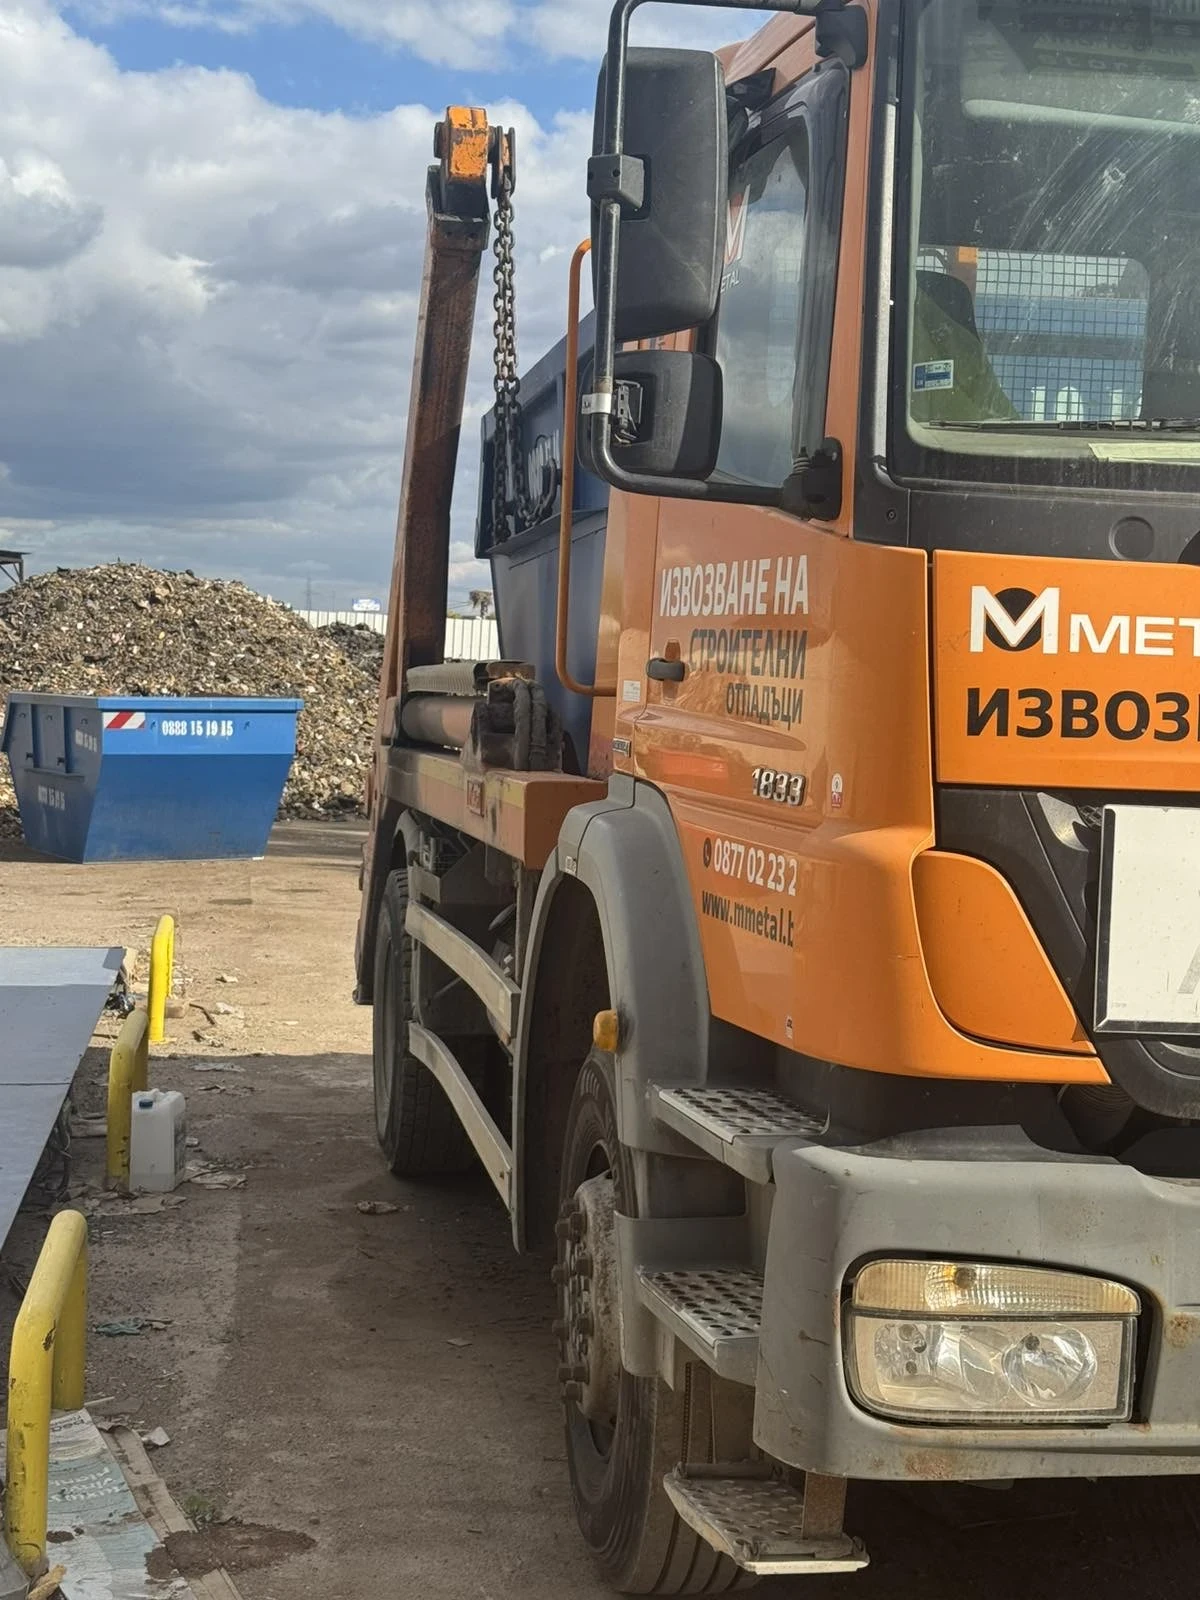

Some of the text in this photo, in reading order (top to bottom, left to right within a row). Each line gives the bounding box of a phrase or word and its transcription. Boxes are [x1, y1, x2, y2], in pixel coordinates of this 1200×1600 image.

[720, 268, 741, 294] ETAL
[660, 555, 809, 617] ИЗВОЗВАНЕ НА
[689, 628, 809, 681] СТРОИТЕЛНИ
[161, 720, 187, 736] 0888
[190, 720, 204, 736] 15
[220, 720, 234, 737] 15
[726, 682, 803, 731] ОТПАДЪЦИ
[966, 687, 1200, 742] ИЗВОЗ
[752, 768, 806, 807] 1833
[714, 838, 798, 897] 0877 02 23 2
